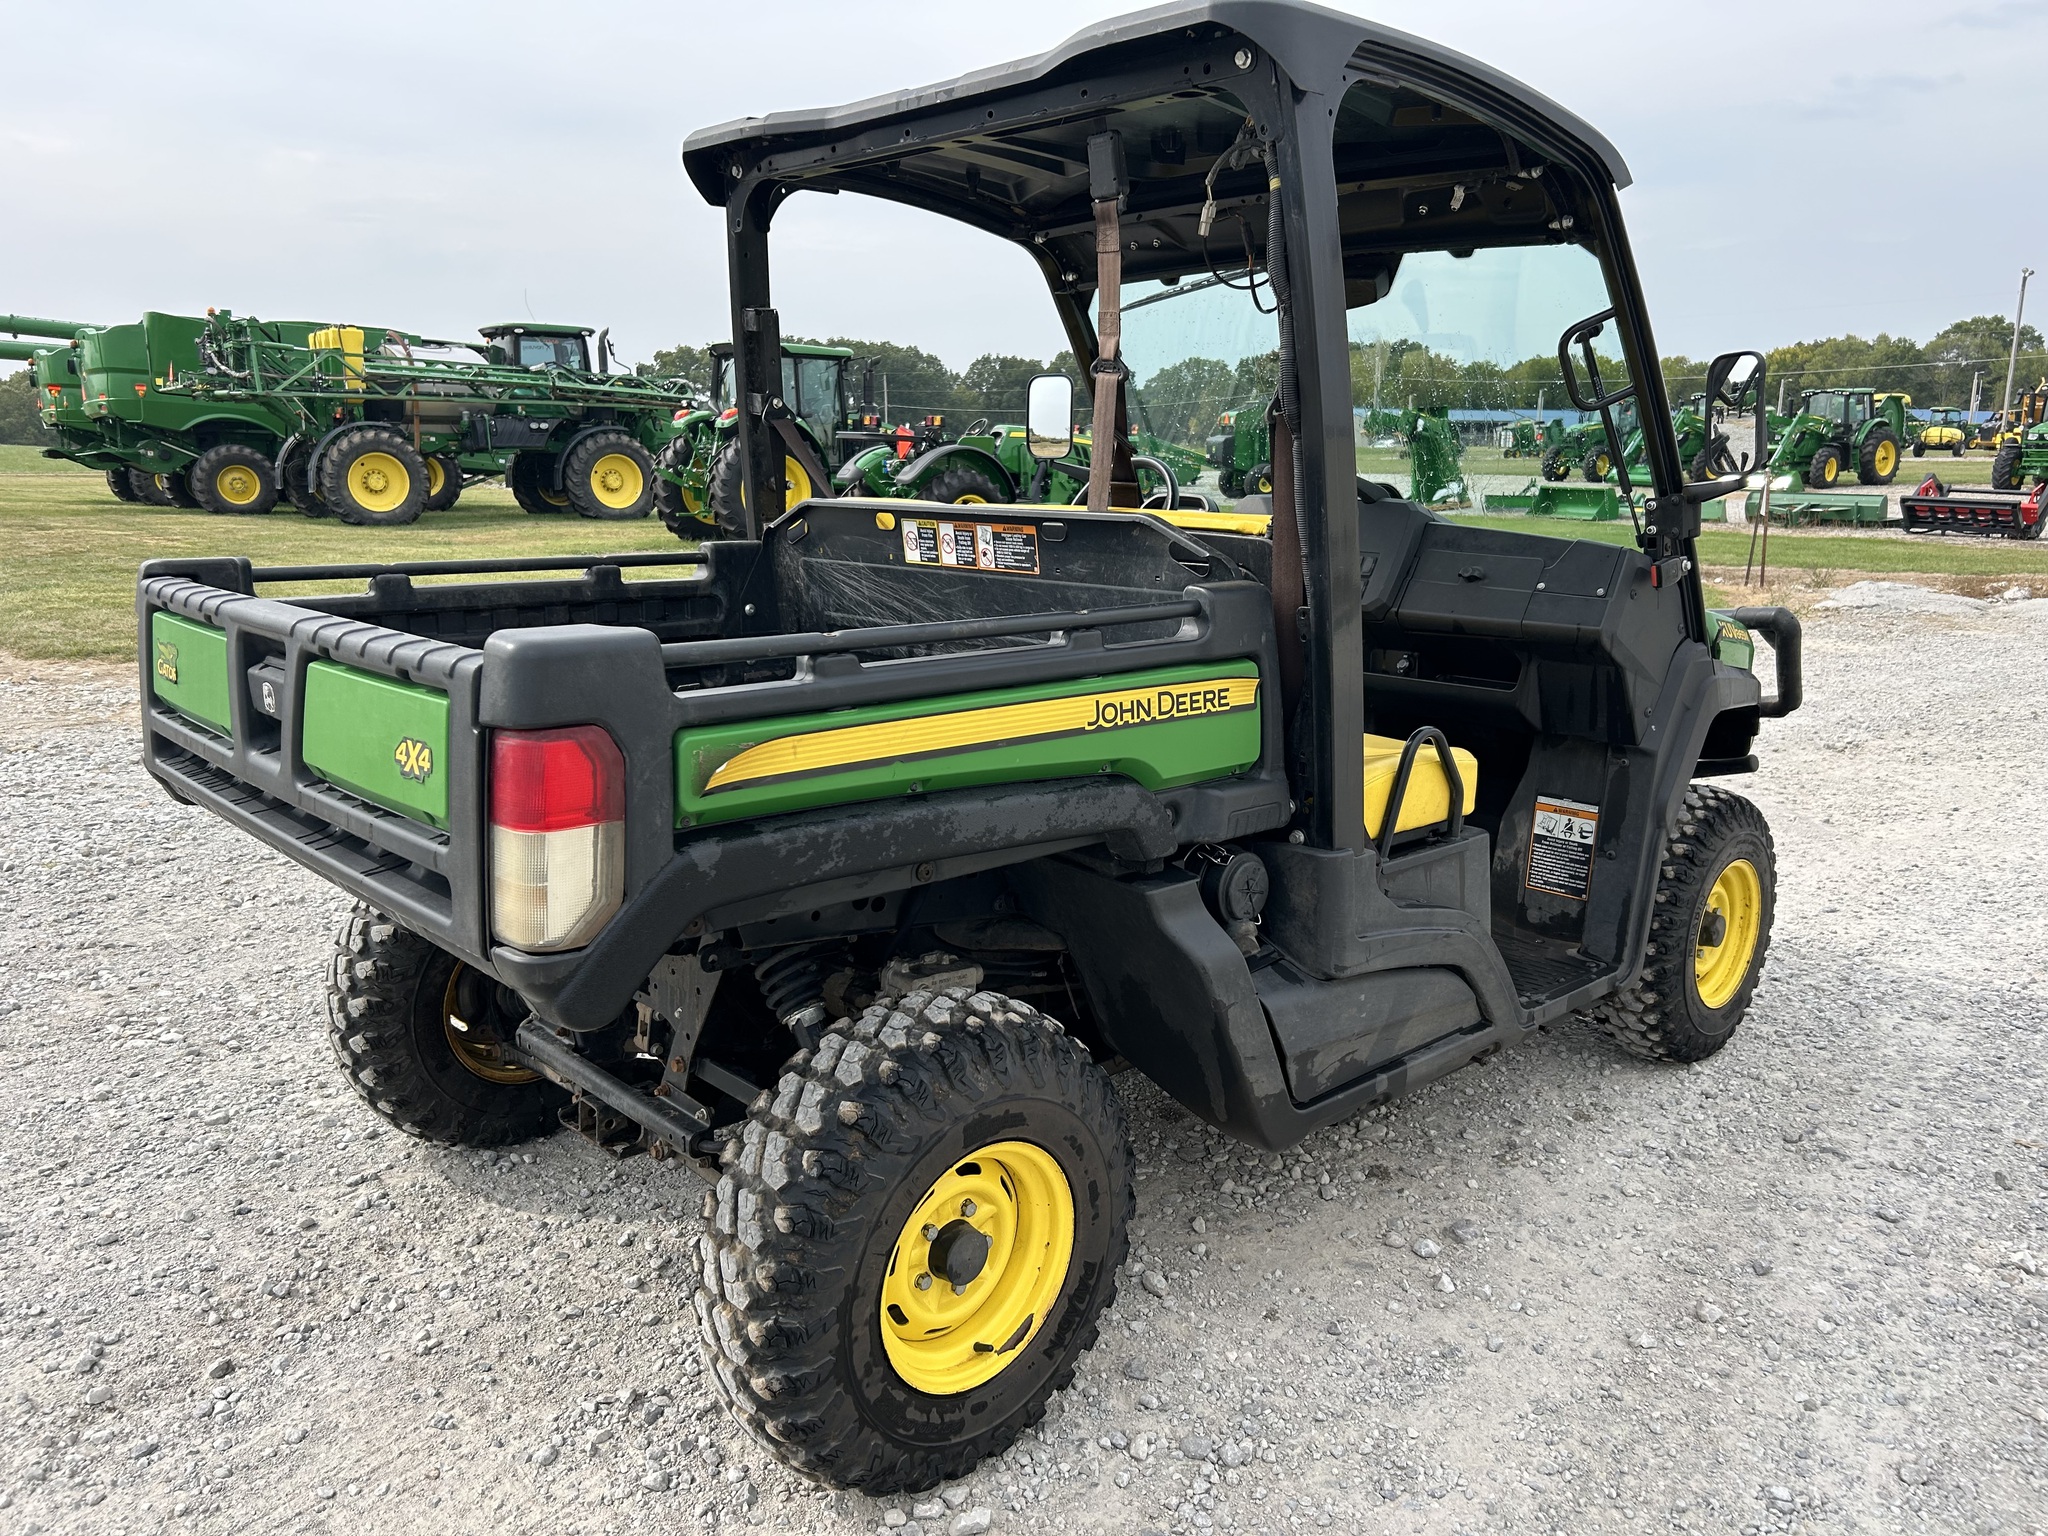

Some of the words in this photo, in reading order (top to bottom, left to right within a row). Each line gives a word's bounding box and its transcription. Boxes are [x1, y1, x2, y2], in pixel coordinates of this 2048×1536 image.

[157, 657, 177, 681] GATOR
[1087, 697, 1151, 727] JOHN
[1157, 688, 1230, 717] DEERE
[395, 739, 431, 776] 4X4
[1558, 807, 1580, 817] WARNING
[1047, 1259, 1098, 1363] PALADIN
